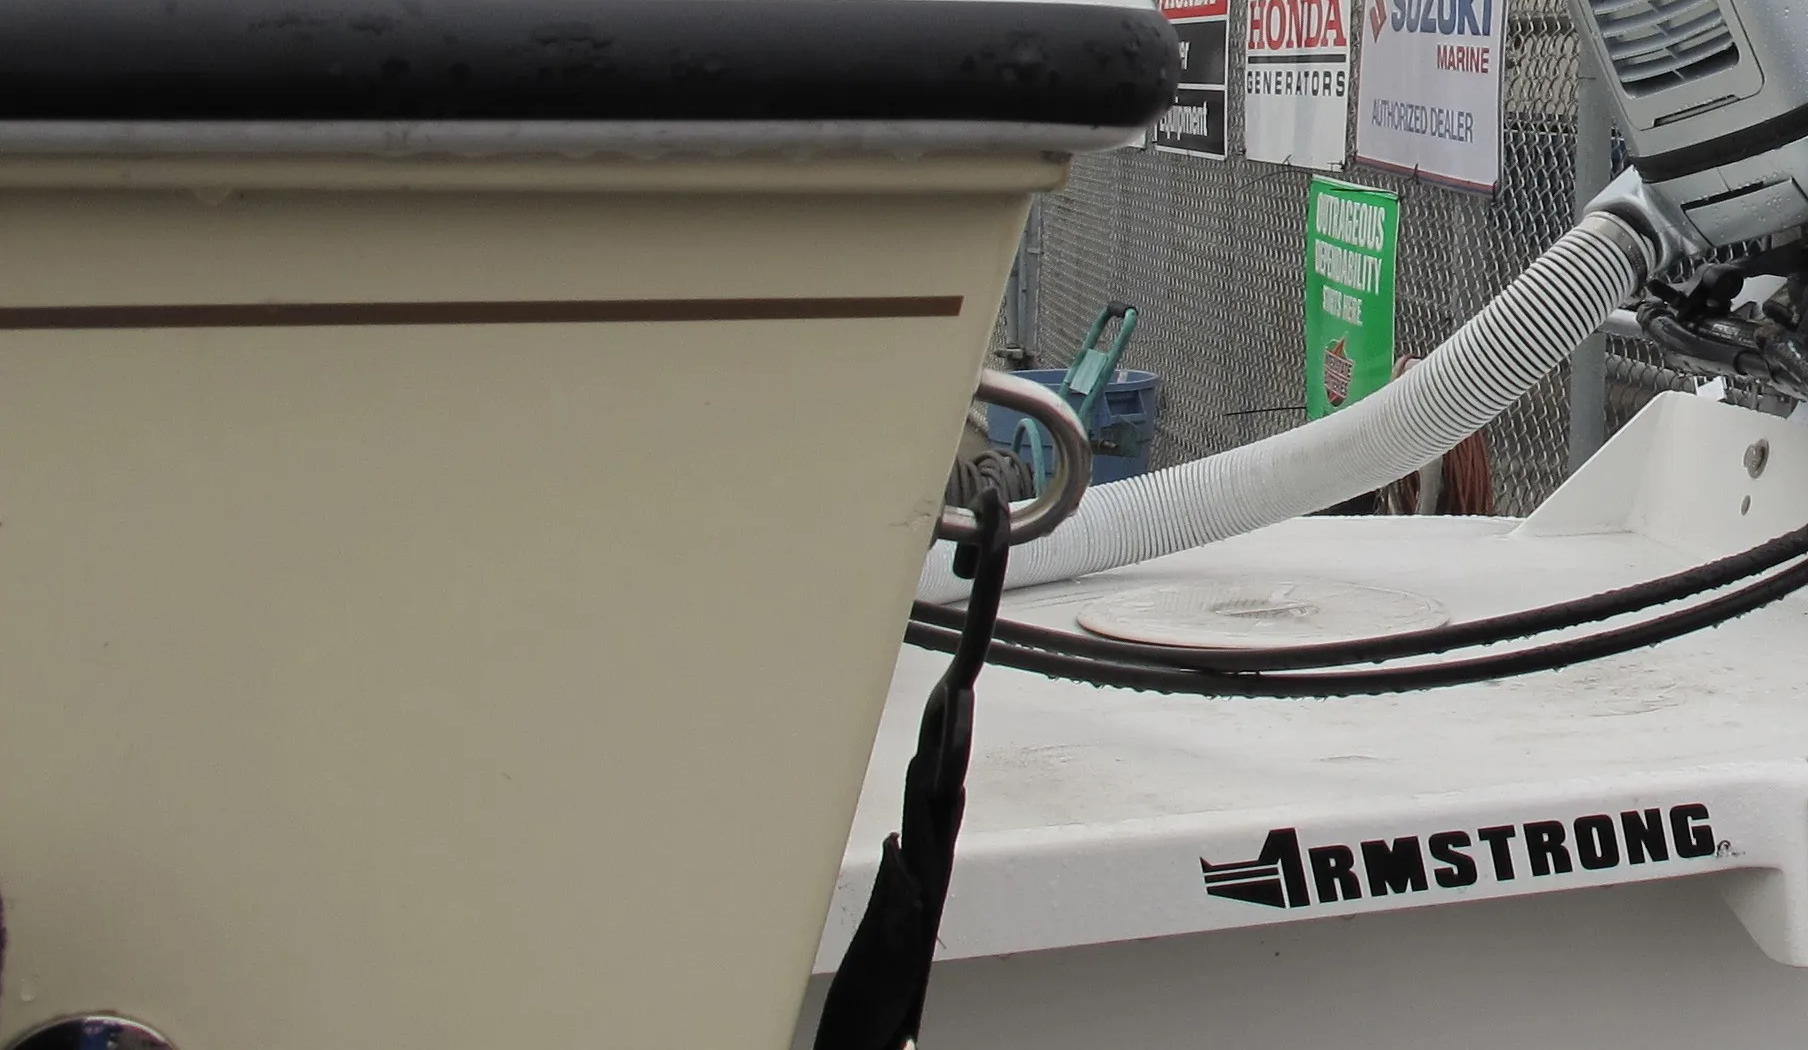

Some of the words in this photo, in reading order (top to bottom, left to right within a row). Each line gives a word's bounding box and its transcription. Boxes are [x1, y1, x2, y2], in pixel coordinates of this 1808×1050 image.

[1436, 44, 1491, 74] MARINE
[1246, 70, 1346, 97] GENERATORS
[1372, 98, 1428, 135] AUTHORIZED
[1430, 107, 1474, 143] DEALER
[1316, 191, 1386, 252] OUTRAGEOUS
[1200, 802, 1717, 909] ARMSTRONG
